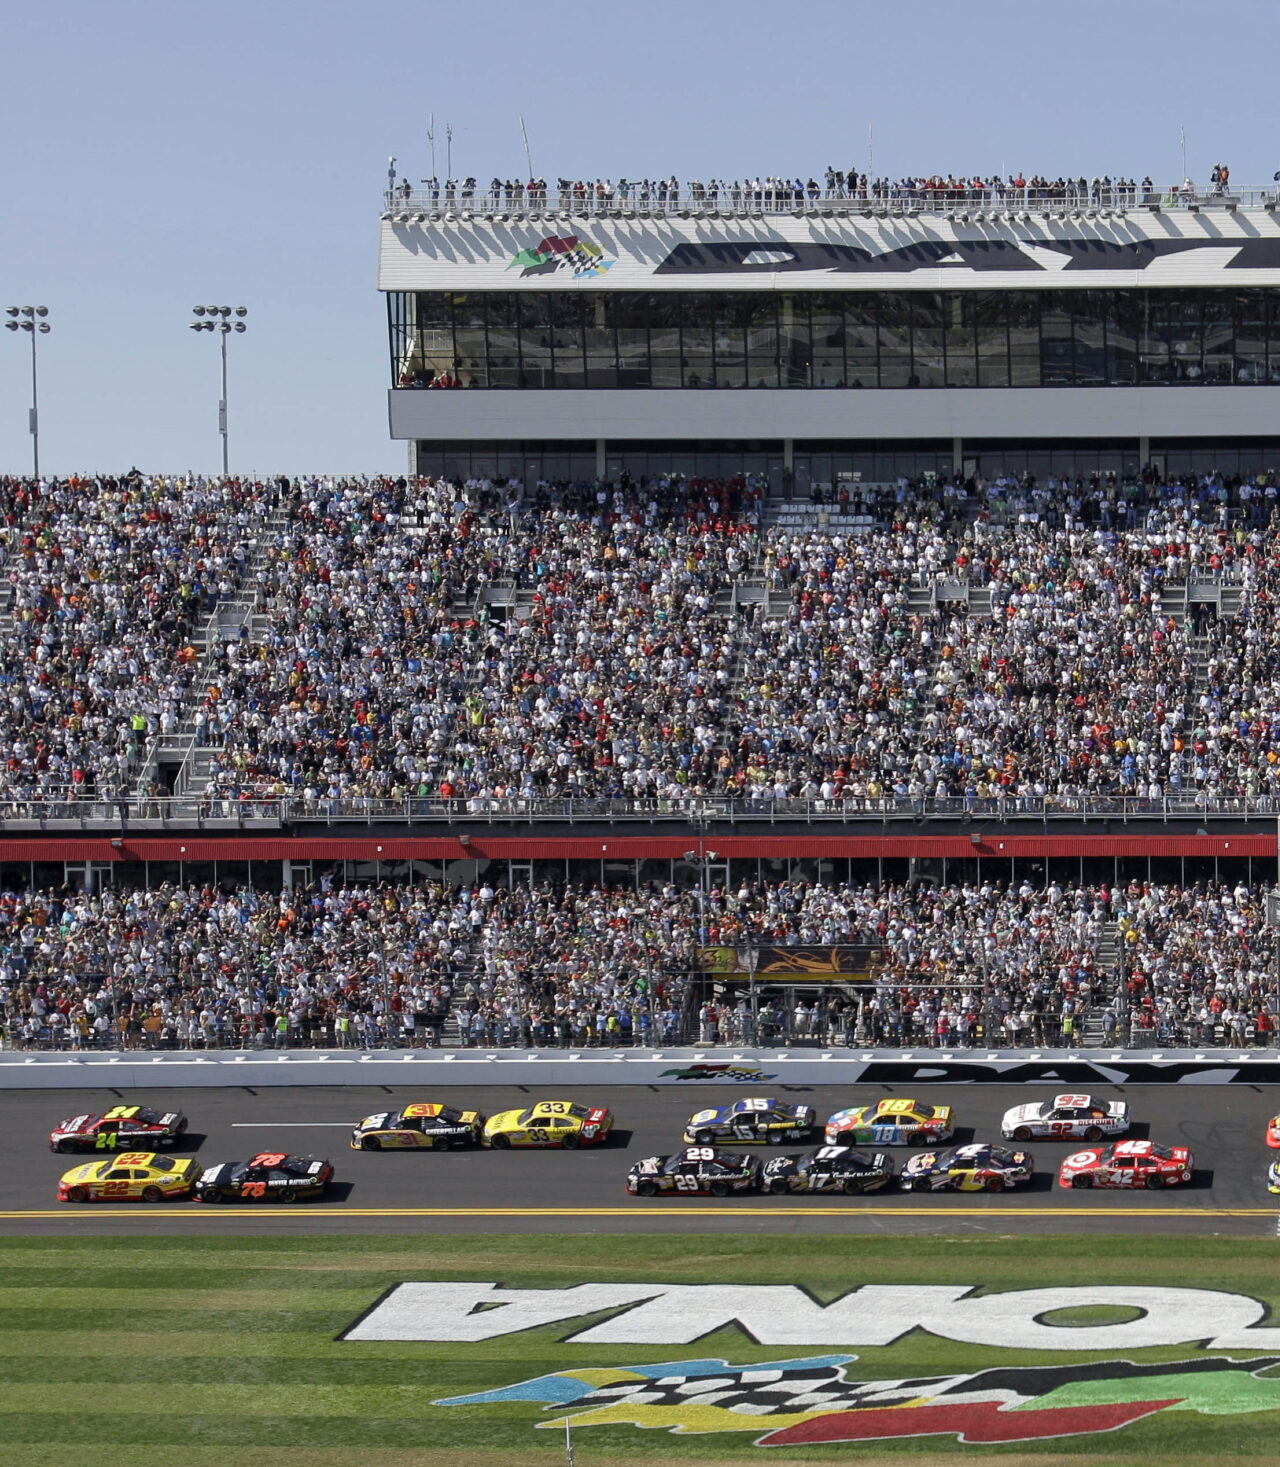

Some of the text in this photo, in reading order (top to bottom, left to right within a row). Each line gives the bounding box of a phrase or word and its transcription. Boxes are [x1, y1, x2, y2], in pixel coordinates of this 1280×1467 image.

[743, 1098, 769, 1110] 15
[881, 1100, 912, 1111] 18
[1057, 1095, 1088, 1106] 92
[104, 1105, 141, 1119] 24
[410, 1104, 436, 1116] 31
[540, 1102, 565, 1113] 33
[527, 1129, 550, 1141] 33
[733, 1125, 755, 1140] 15
[874, 1127, 896, 1141] 18
[1051, 1122, 1073, 1136] 92
[96, 1132, 117, 1149] 24
[397, 1132, 419, 1145] 31
[686, 1147, 715, 1160] 29
[815, 1146, 850, 1159] 17
[1116, 1141, 1152, 1153] 42
[117, 1153, 150, 1165] 22
[250, 1154, 285, 1166] 78
[674, 1174, 699, 1191] 29
[808, 1174, 831, 1188] 17
[1110, 1170, 1135, 1183] 42
[103, 1181, 130, 1196] 22
[241, 1181, 267, 1197] 78
